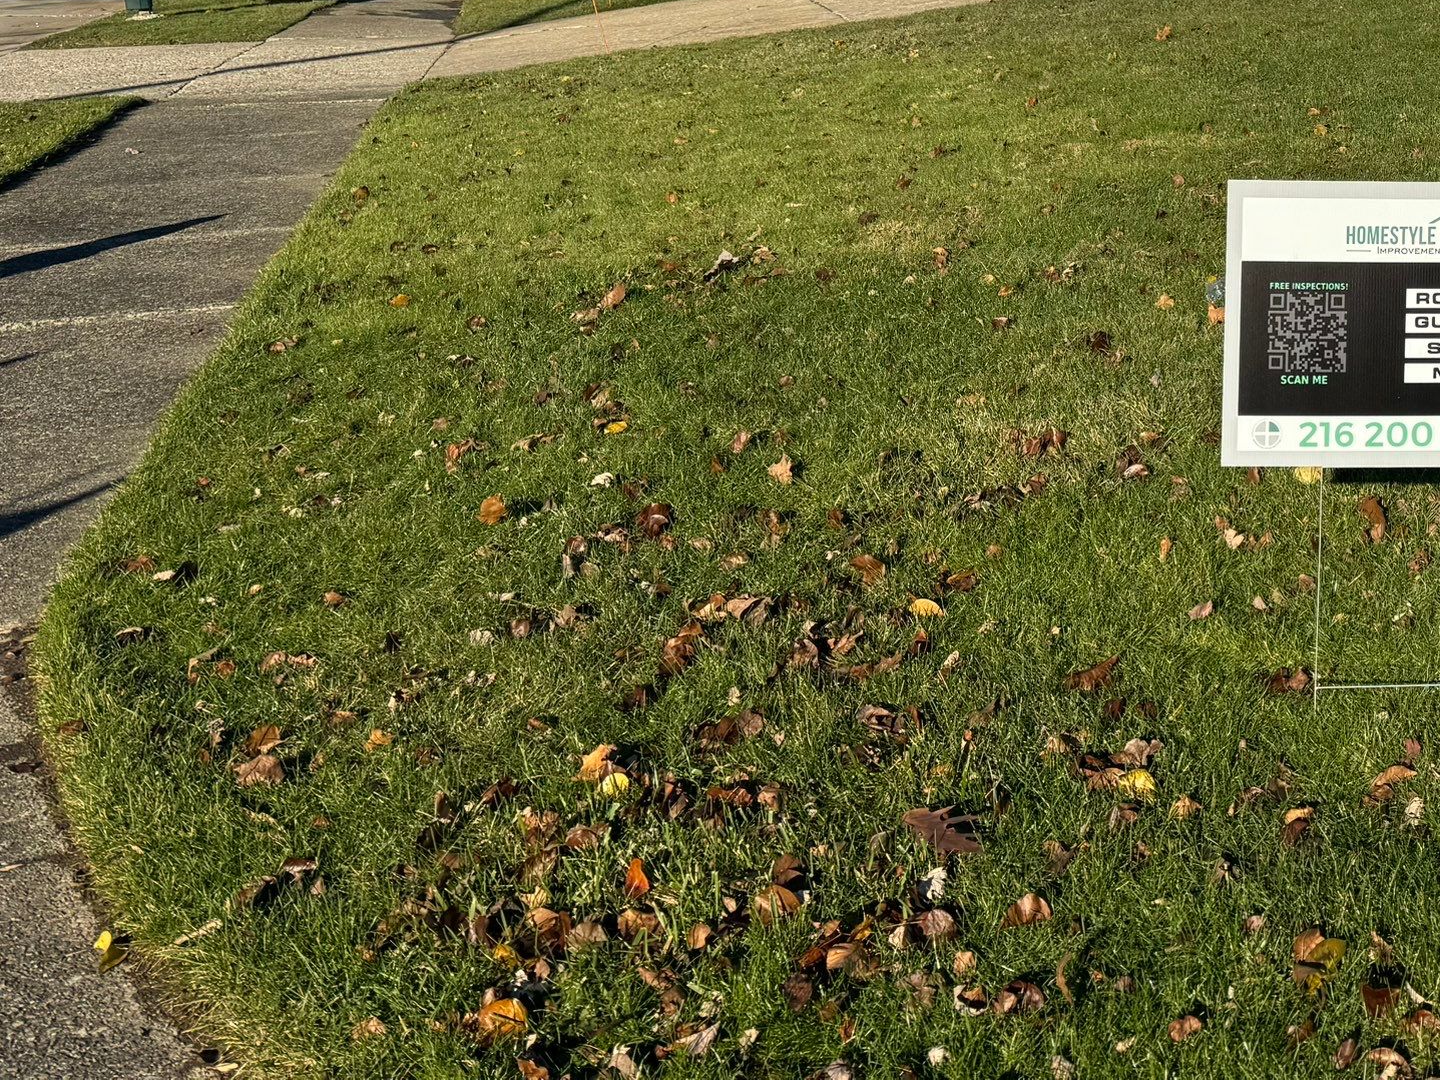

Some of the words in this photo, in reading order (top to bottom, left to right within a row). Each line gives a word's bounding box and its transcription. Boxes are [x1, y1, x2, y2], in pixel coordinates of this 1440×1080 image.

[1346, 225, 1436, 245] HOMESTYLE
[1269, 282, 1290, 290] FREE
[1292, 282, 1349, 290] INSPECTIONS!
[1280, 375, 1309, 384] SCAN
[1312, 375, 1328, 384] ME
[1299, 422, 1354, 448] 216
[1364, 422, 1432, 448] 200
